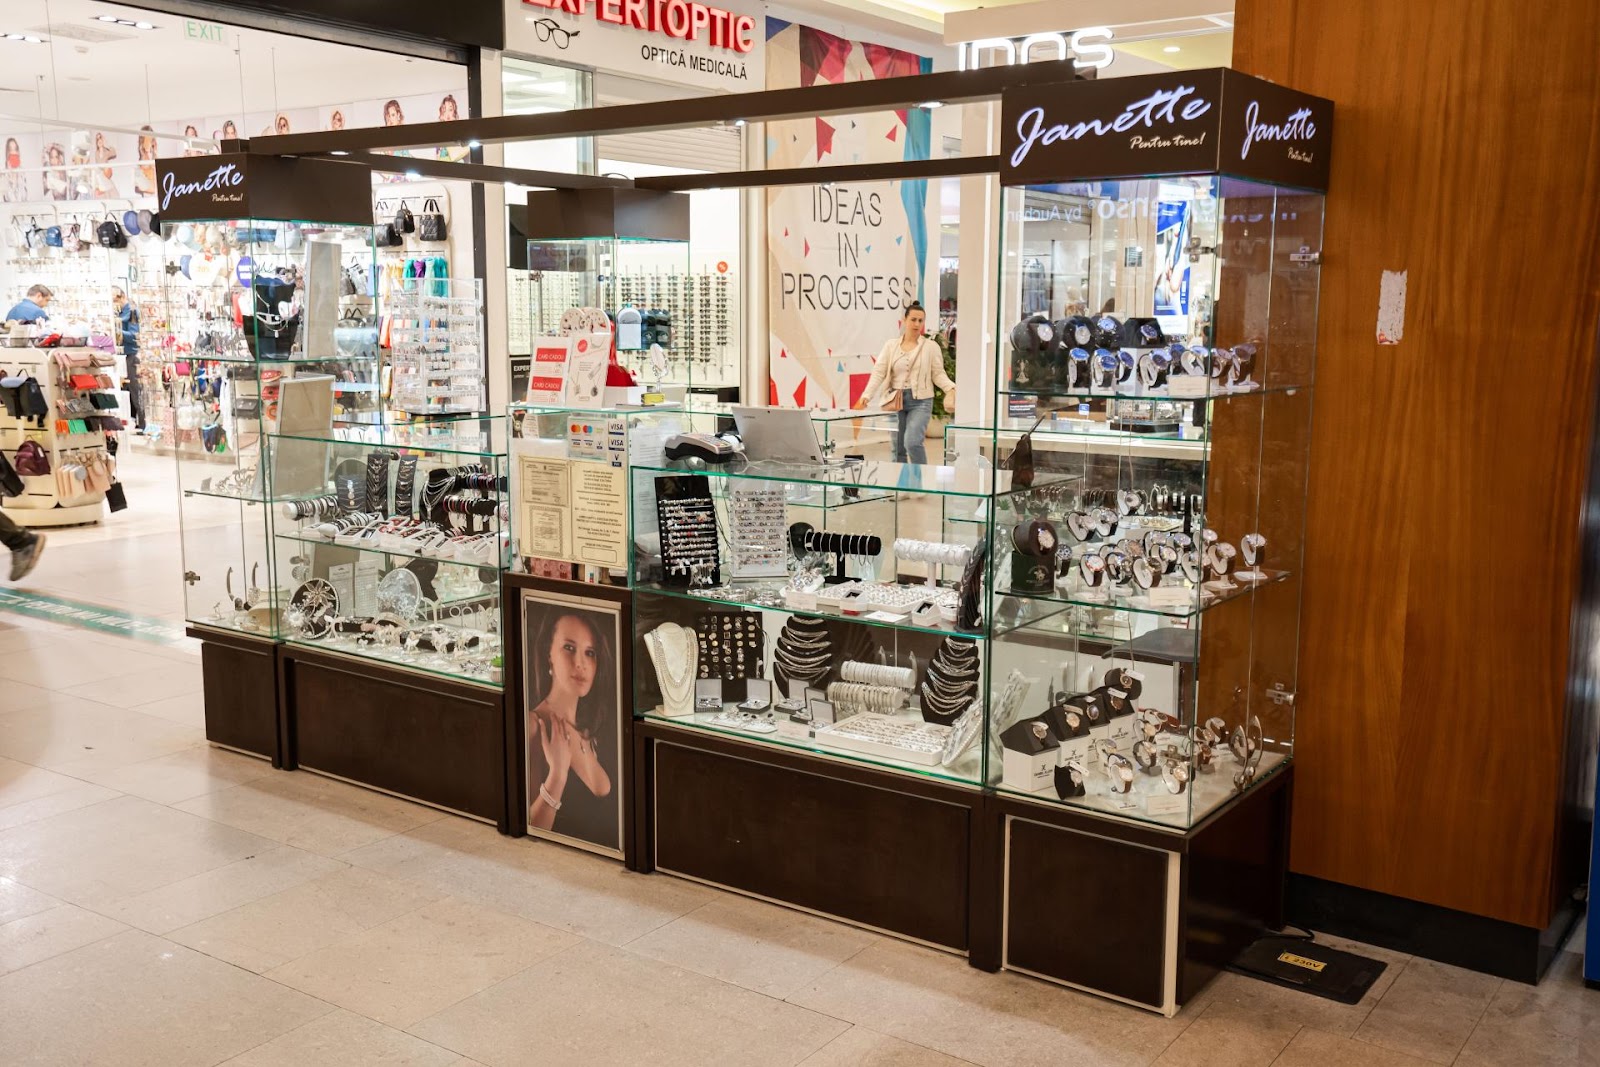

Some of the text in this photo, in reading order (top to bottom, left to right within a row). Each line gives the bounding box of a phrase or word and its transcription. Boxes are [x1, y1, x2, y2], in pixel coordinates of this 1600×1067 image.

[187, 20, 224, 41] EXIT
[520, 0, 755, 53] ERTOPTIC
[641, 45, 748, 80] OPTICĂ MEDICALĂ
[1010, 84, 1212, 168] Janette
[1129, 135, 1172, 150] Pentru
[1240, 100, 1317, 160] Janette
[162, 163, 244, 210] Janette
[812, 185, 882, 227] IDEAS
[837, 231, 859, 268] IN
[781, 272, 914, 311] PROGRESS
[610, 423, 624, 431] VISA
[610, 439, 624, 447] VISA
[1293, 958, 1321, 968] 230V
